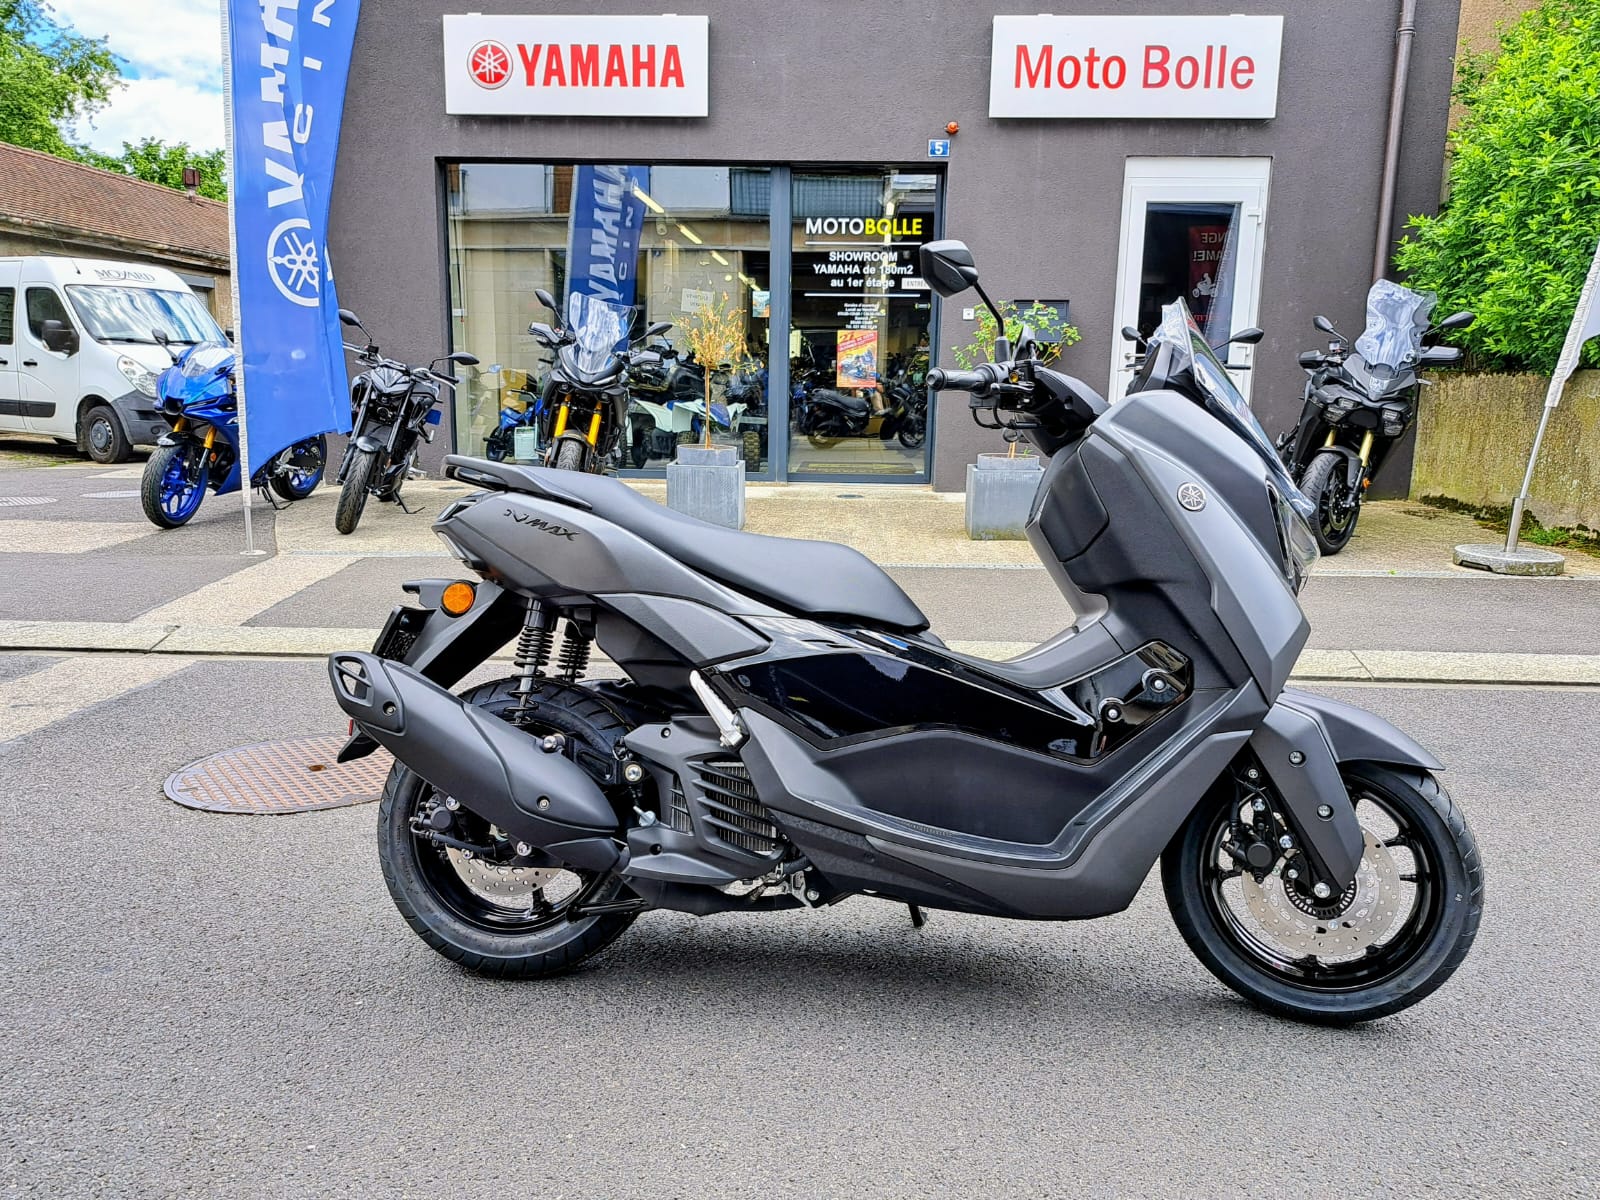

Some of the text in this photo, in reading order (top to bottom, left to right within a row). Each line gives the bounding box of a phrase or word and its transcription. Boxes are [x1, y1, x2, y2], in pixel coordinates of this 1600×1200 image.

[517, 43, 685, 88] YAMAHA
[1014, 44, 1256, 90] Moto Bolle
[935, 141, 944, 155] 5
[805, 218, 923, 236] MOTOBOLLE
[828, 251, 898, 262] SHOWROOM
[813, 264, 914, 275] YAMAHA de 180m2
[830, 277, 896, 289] au 1er étage
